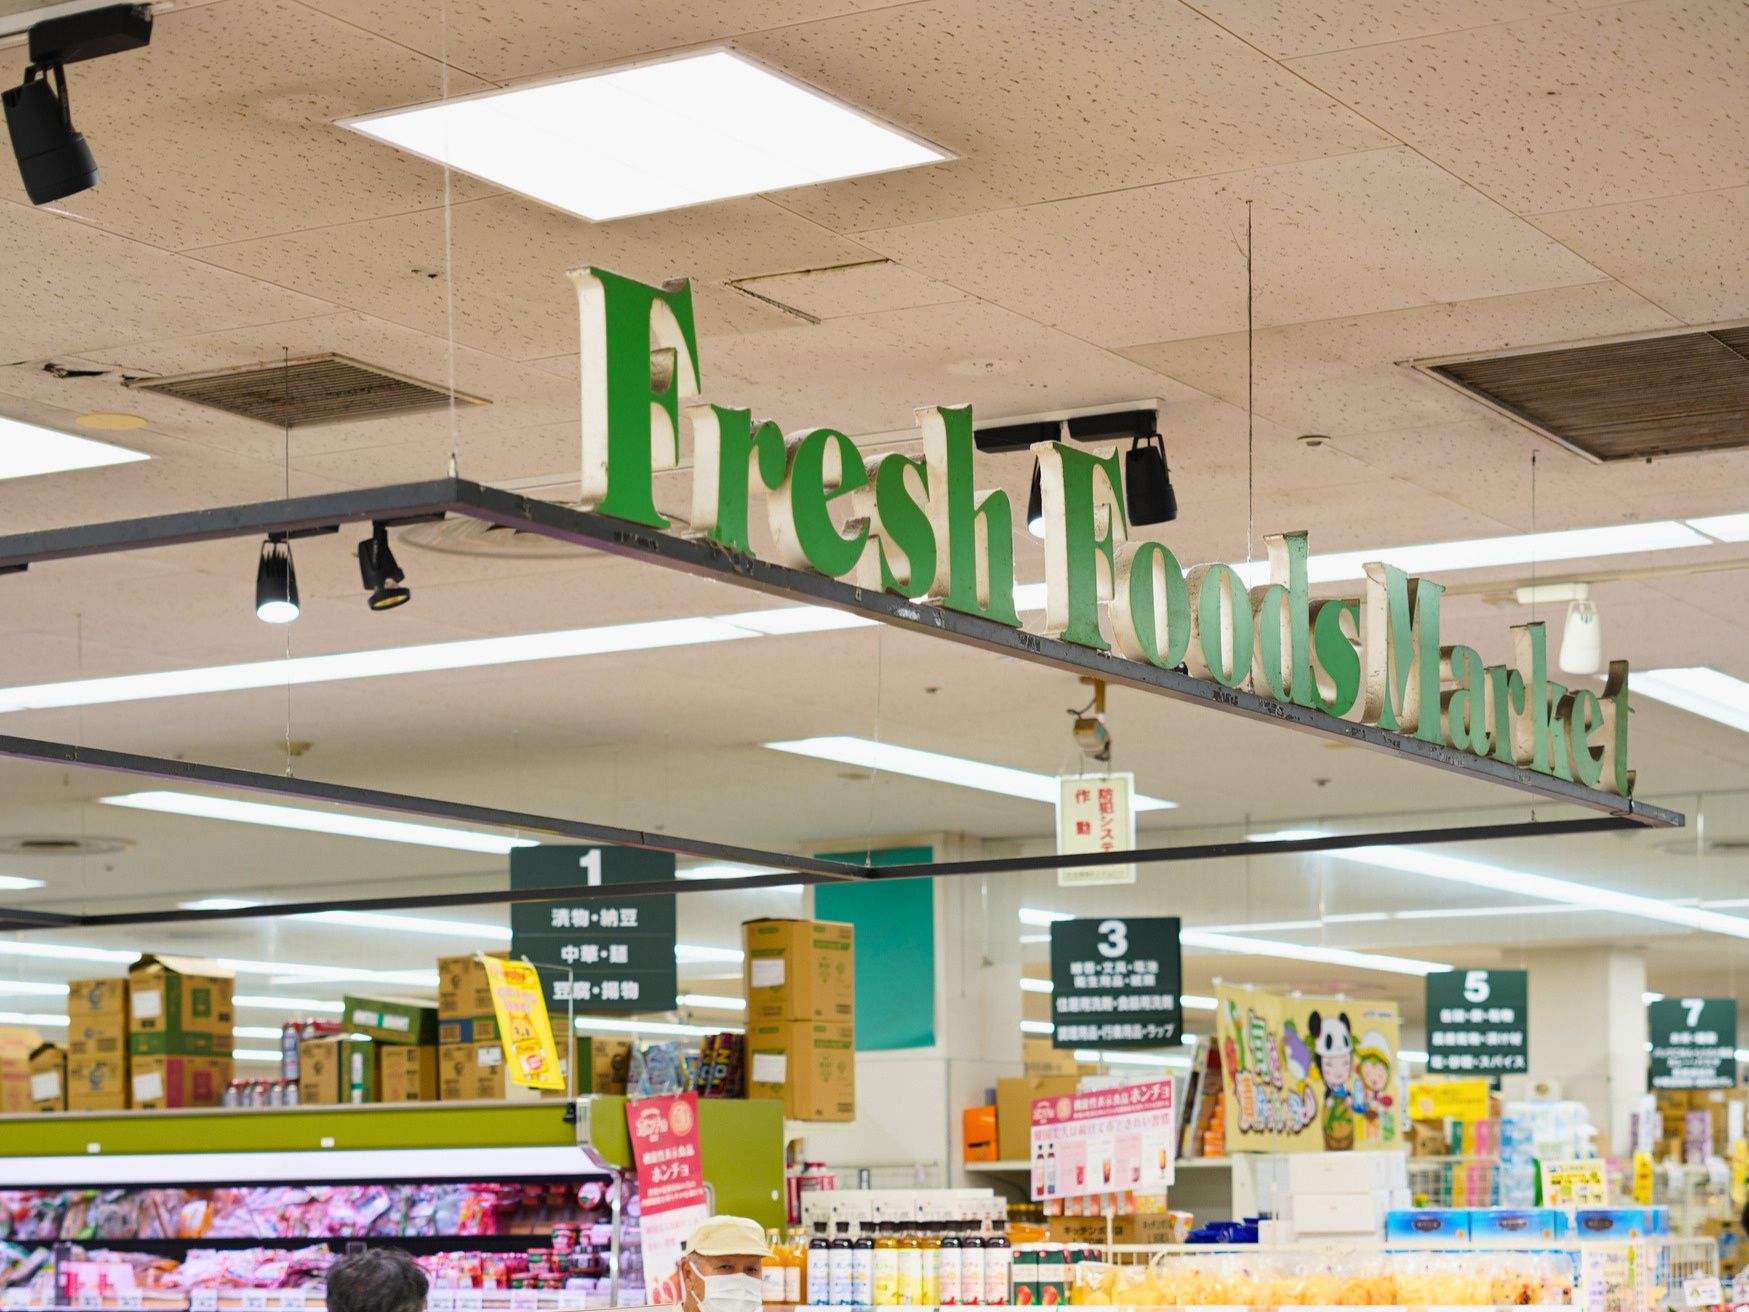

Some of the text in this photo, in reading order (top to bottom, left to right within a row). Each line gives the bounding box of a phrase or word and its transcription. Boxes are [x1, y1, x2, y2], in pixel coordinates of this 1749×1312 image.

[565, 266, 1635, 797] Fresh Foods Market
[1075, 788, 1092, 835] 作動
[1097, 788, 1115, 864] 防犯システ
[579, 849, 602, 887] 1
[551, 908, 639, 928] 漬物・納豆
[1097, 920, 1129, 957] 3
[1463, 971, 1491, 1003] 5
[1681, 998, 1705, 1028] 7
[651, 1162, 690, 1185] ホンチョ
